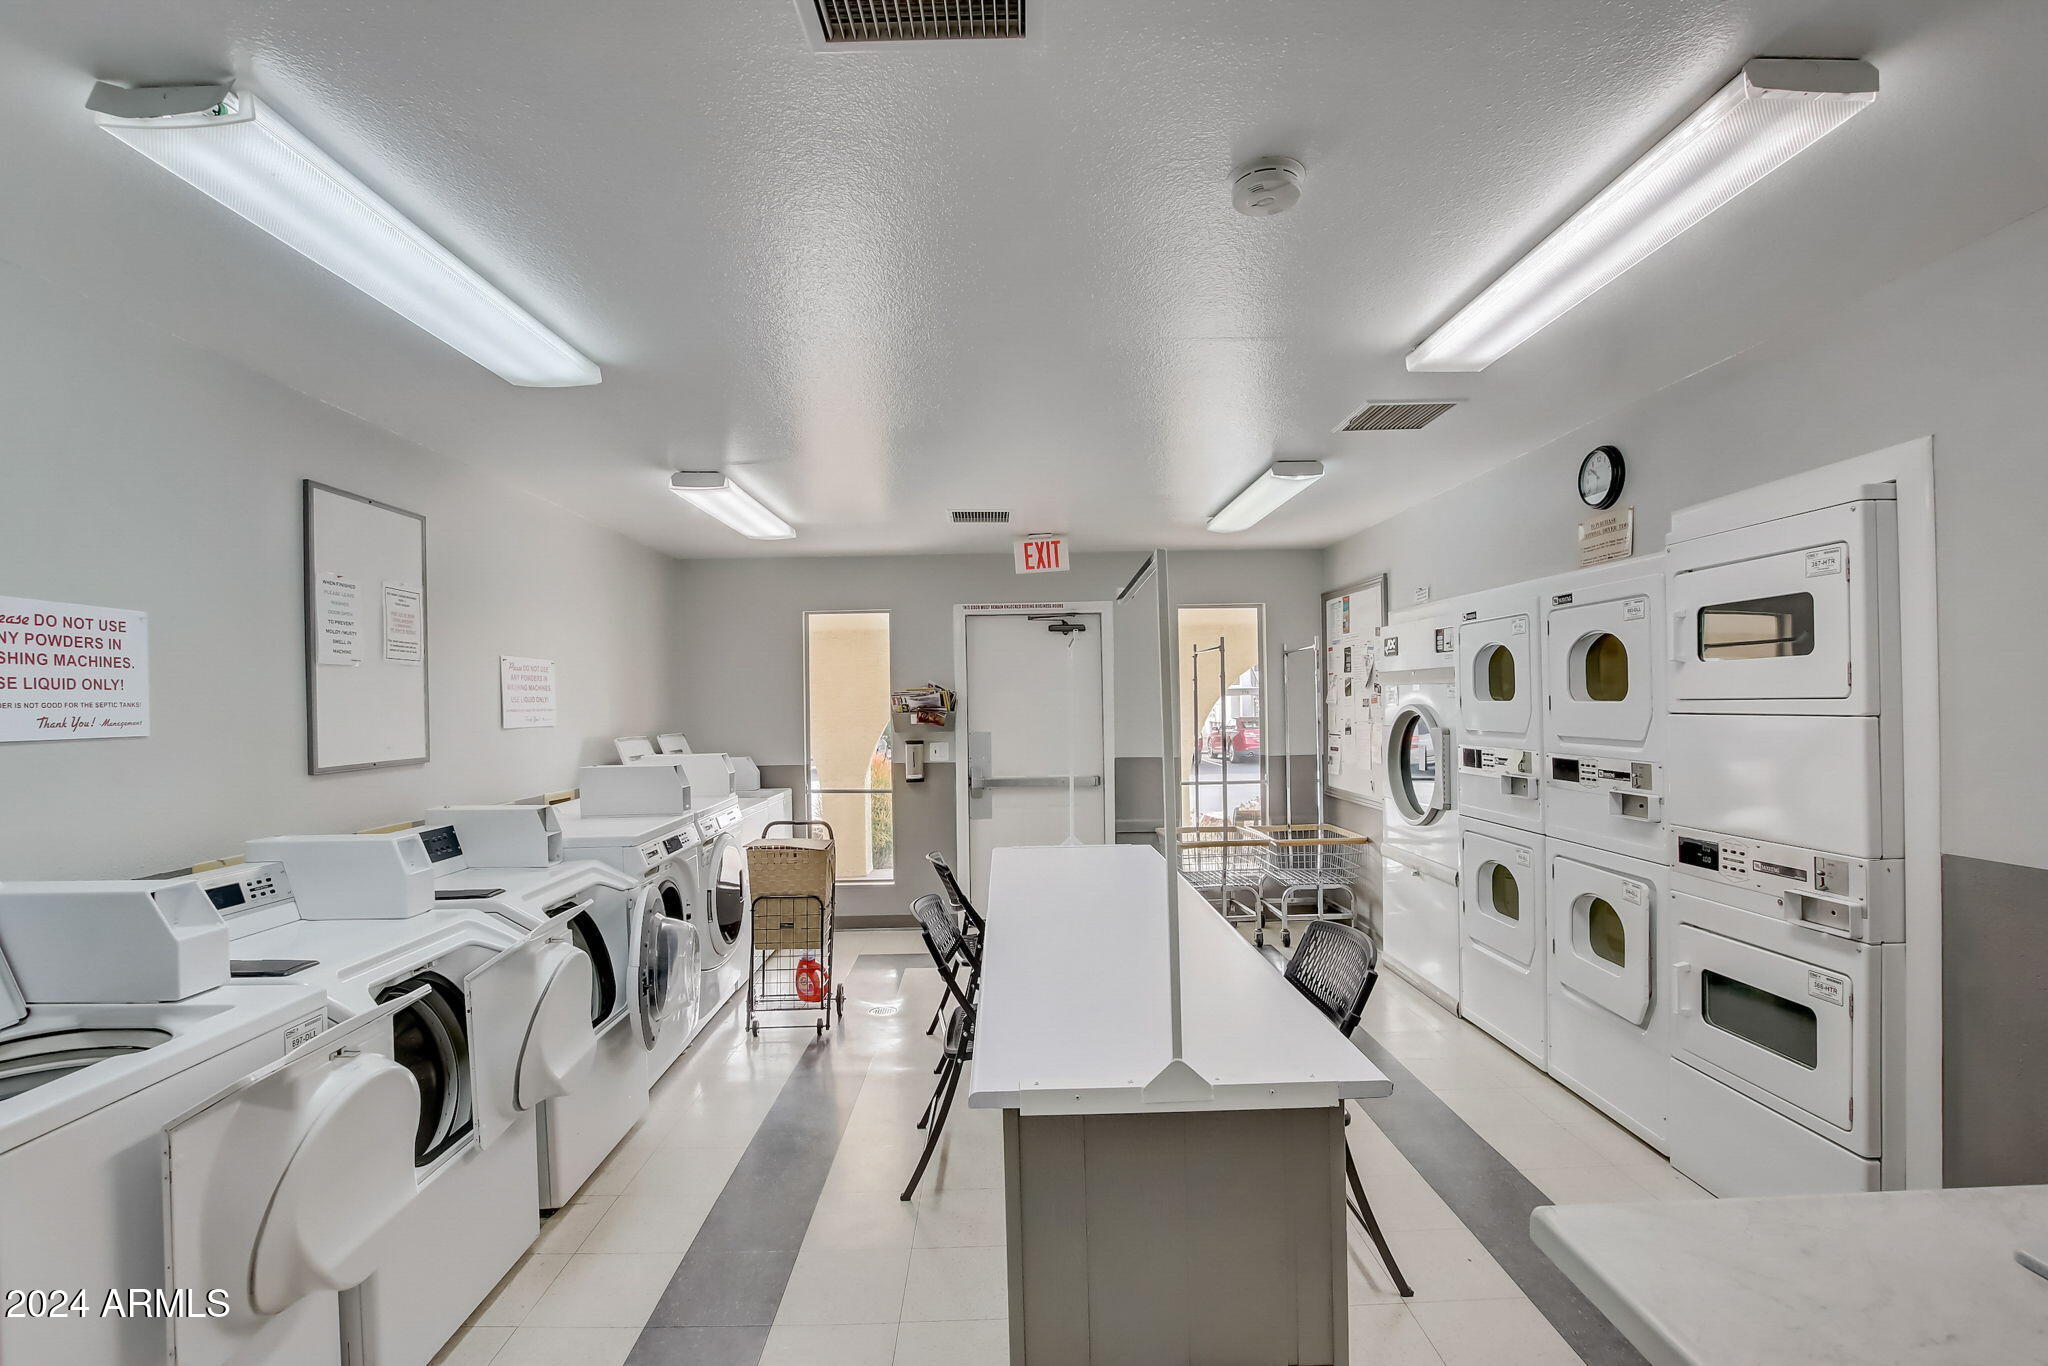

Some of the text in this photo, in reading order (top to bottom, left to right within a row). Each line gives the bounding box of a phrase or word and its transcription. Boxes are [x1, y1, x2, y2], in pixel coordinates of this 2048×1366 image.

[1024, 540, 1060, 570] EXIT
[34, 614, 57, 628] DO
[63, 616, 94, 630] NOT
[99, 620, 127, 633] USE
[25, 633, 104, 650] POWDERS
[109, 639, 122, 650] IN
[53, 654, 135, 669] MACHINES.
[24, 677, 77, 691] LIQUID
[81, 679, 125, 691] ONLY!
[36, 717, 67, 729] Thank
[70, 716, 96, 732] You!
